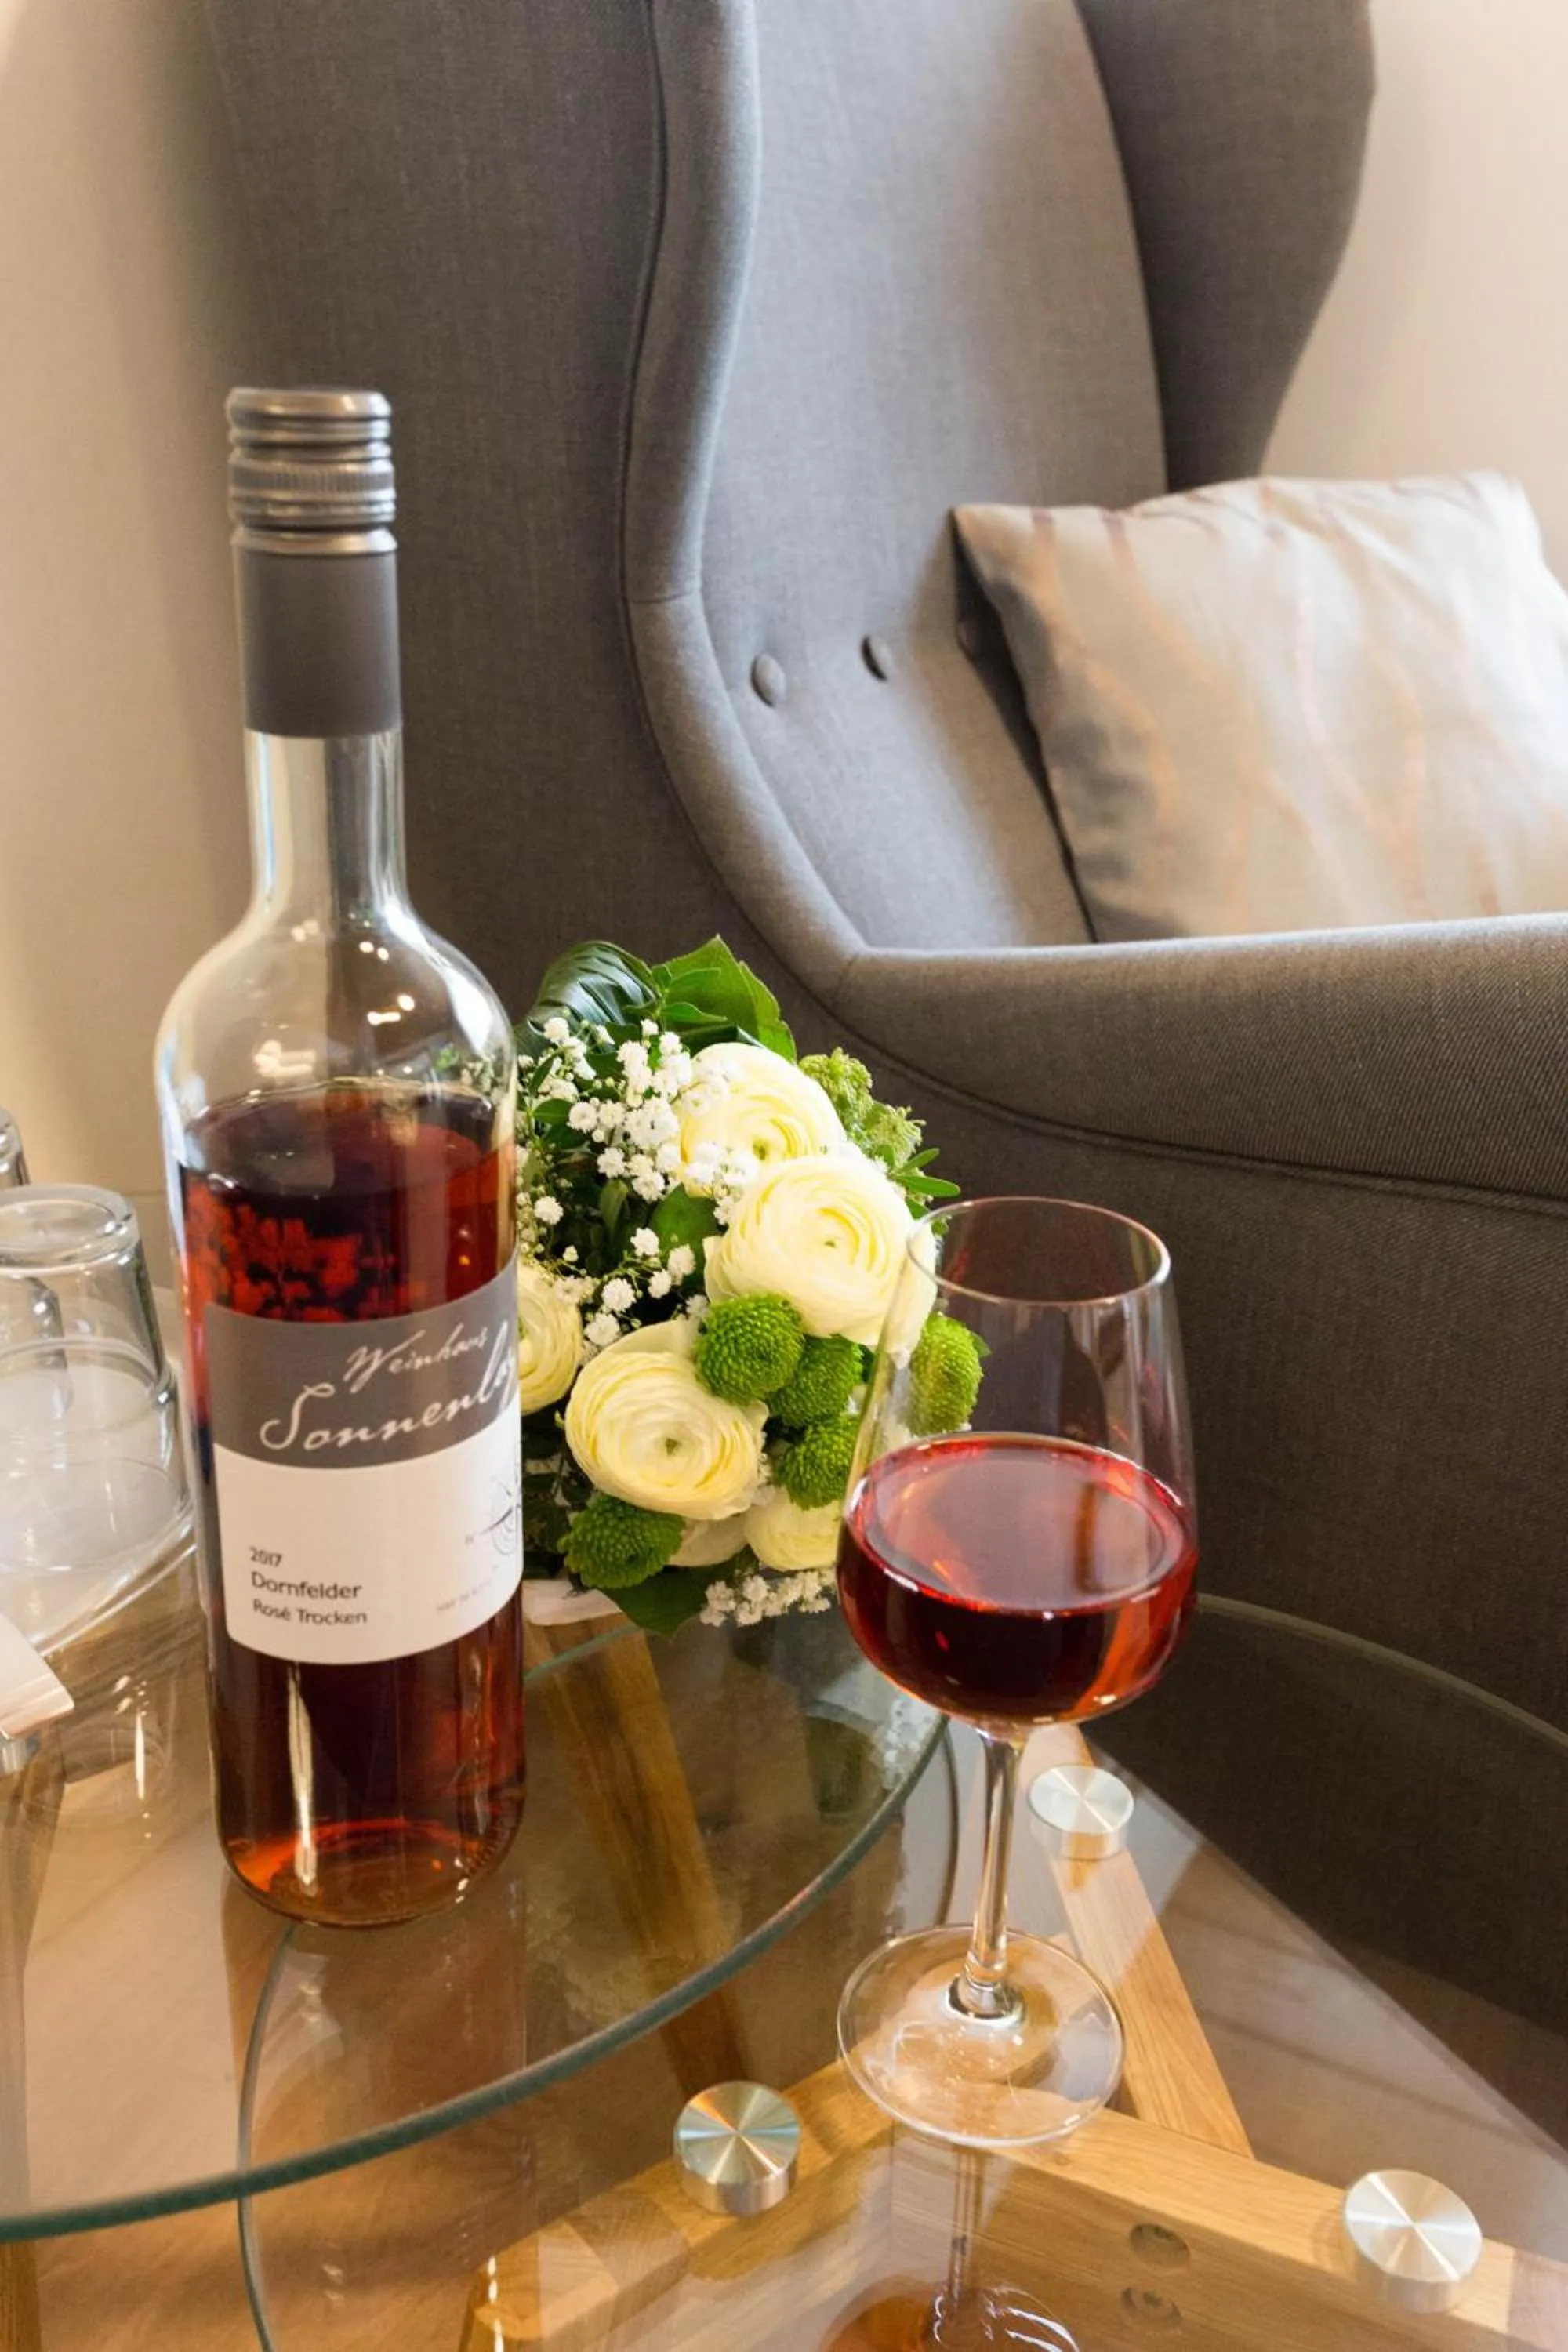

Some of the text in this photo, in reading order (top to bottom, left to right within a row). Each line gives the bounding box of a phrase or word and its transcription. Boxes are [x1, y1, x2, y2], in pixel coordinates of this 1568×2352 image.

[249, 1546, 283, 1567] 2017
[251, 1570, 363, 1601] Dornfelder
[252, 1598, 368, 1626] Rosé Trocken
